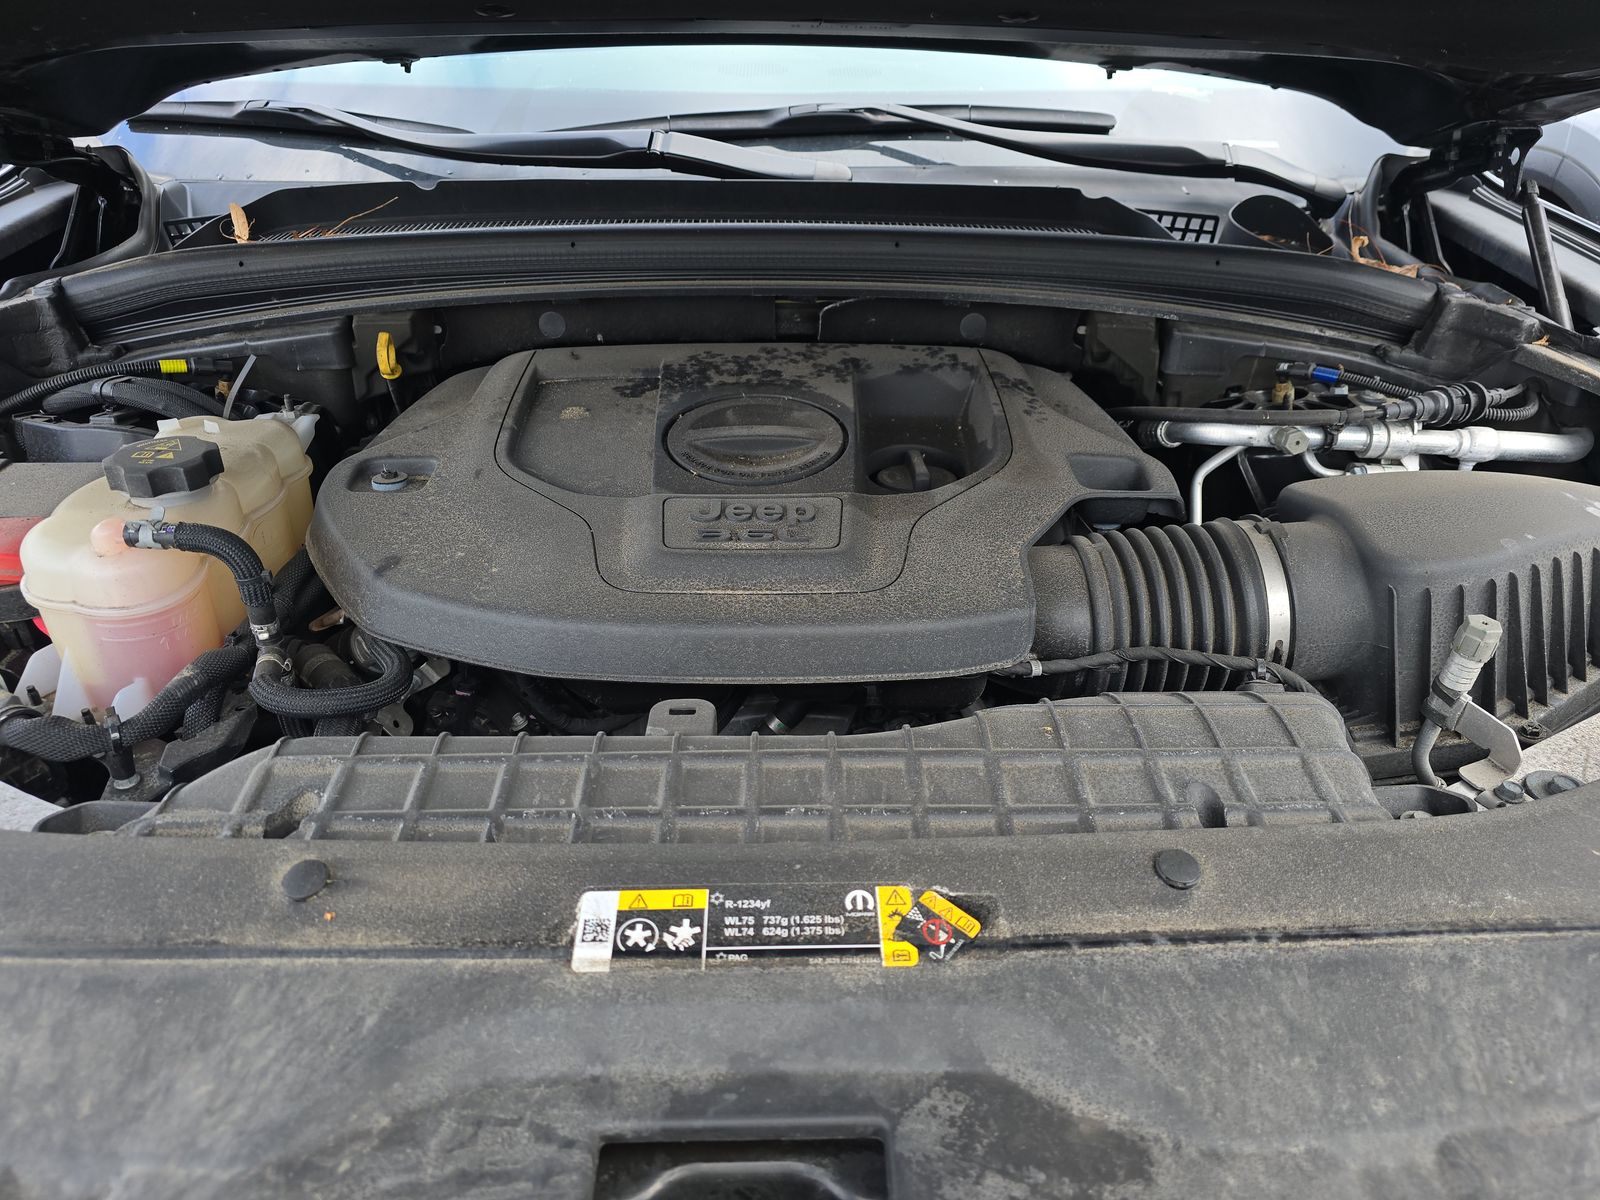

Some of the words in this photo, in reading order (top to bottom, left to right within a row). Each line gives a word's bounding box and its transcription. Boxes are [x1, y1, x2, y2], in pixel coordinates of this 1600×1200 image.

[690, 499, 817, 528] Jeep
[724, 899, 771, 910] R-1234yf
[724, 916, 755, 925] WL75
[762, 915, 788, 926] 737g
[790, 915, 822, 926] (1.625
[824, 915, 845, 925] lbs)
[724, 927, 755, 936] WL74
[762, 927, 788, 937] 624g
[790, 927, 822, 937] (1.375
[824, 926, 845, 936] lbs)
